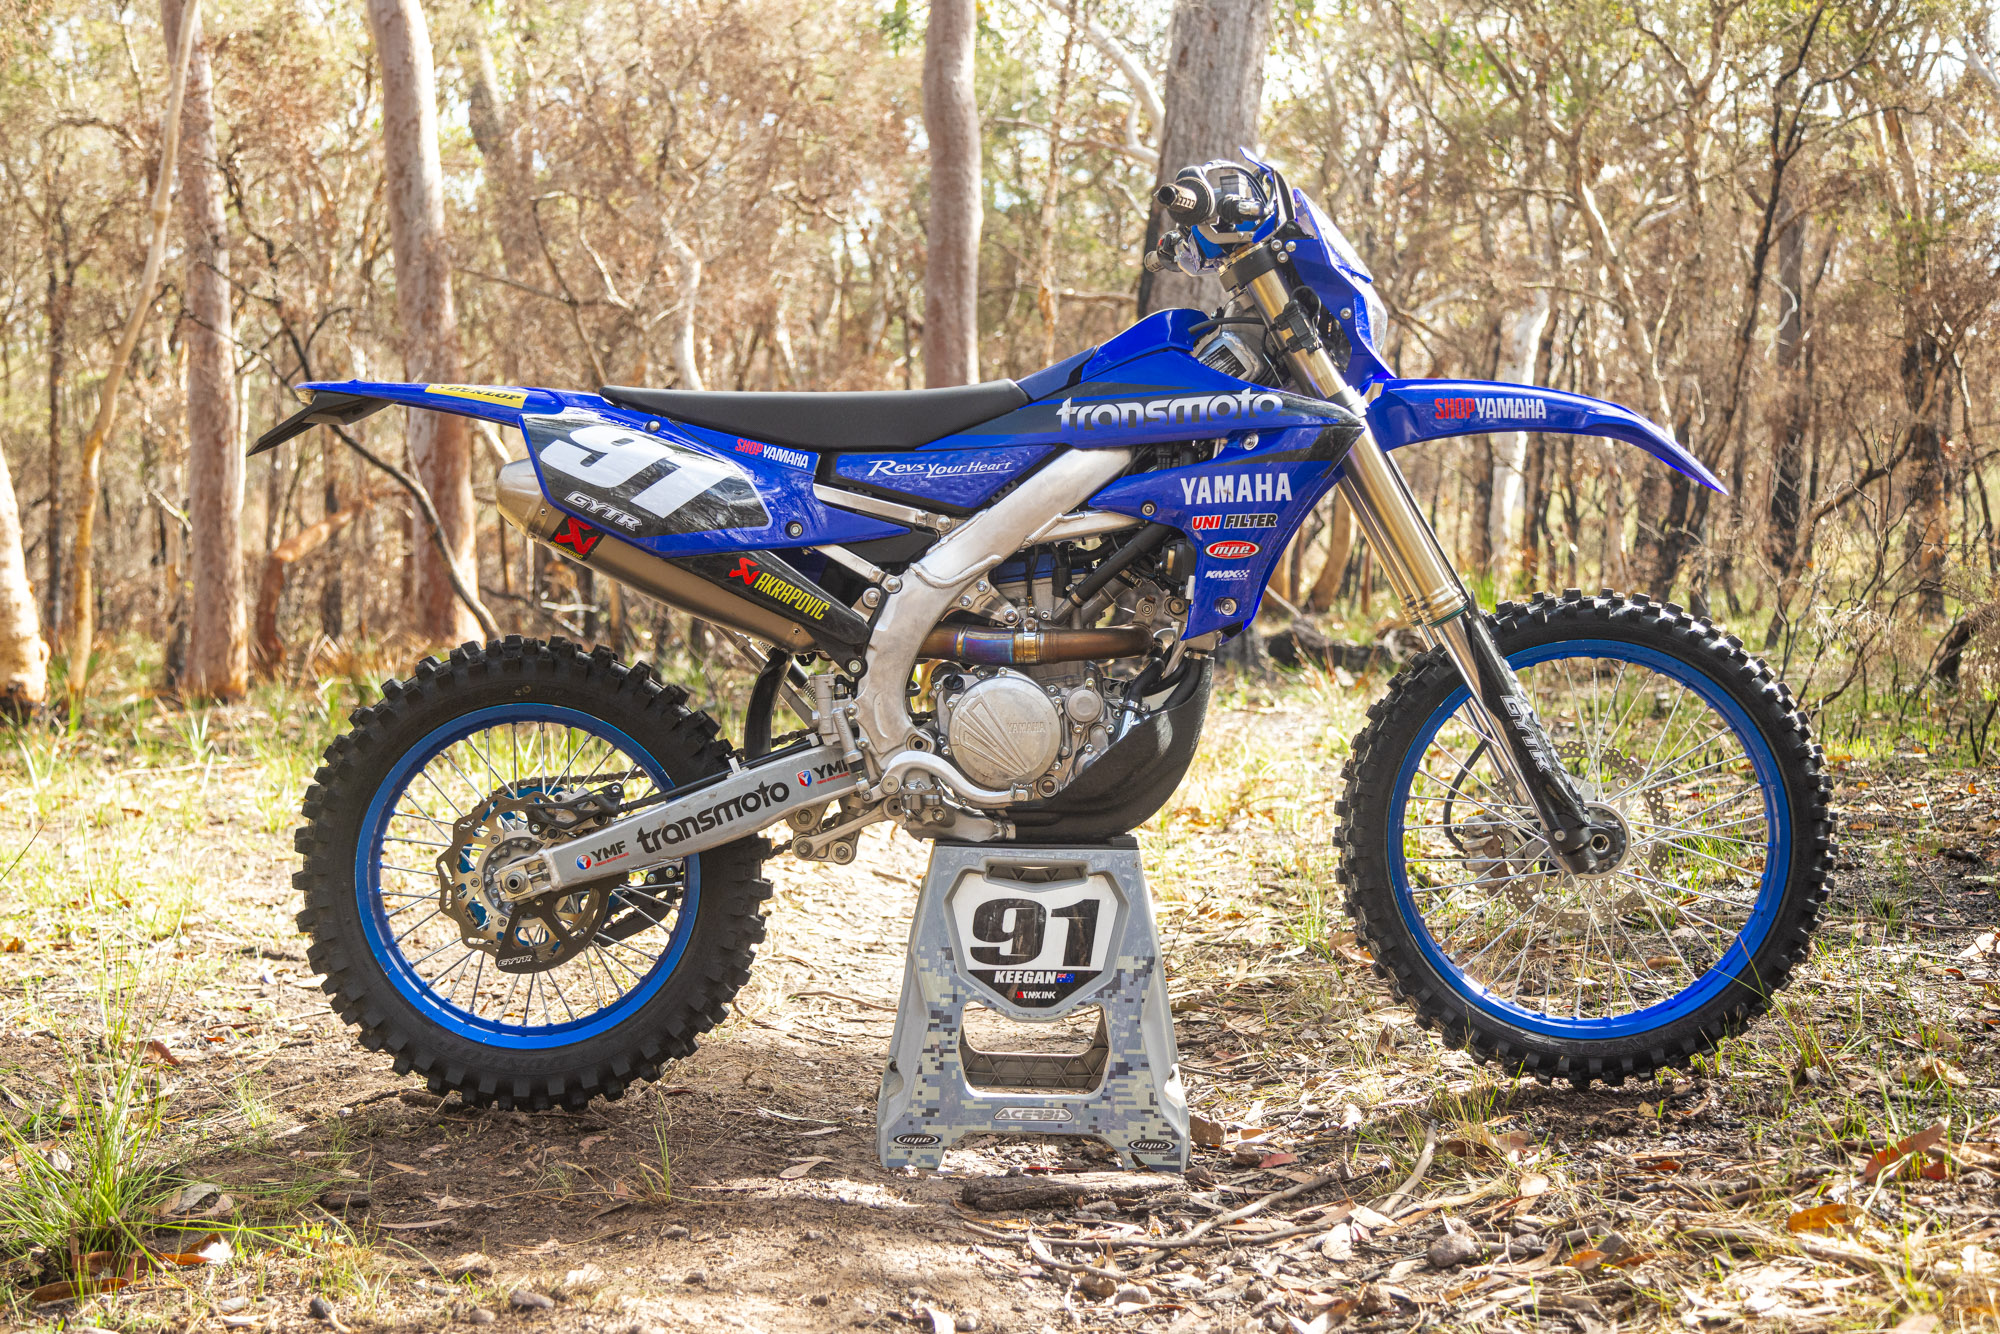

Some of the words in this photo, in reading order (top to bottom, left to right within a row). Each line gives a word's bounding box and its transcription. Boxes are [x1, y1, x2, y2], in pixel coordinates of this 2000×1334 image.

[1056, 387, 1284, 432] transmoto
[540, 426, 732, 519] 91
[1180, 473, 1292, 505] YAMAHA
[564, 491, 642, 531] GYTR
[1192, 515, 1222, 530] UNI
[1224, 513, 1278, 529] FILTER
[1205, 570, 1240, 579] KMX
[1500, 696, 1553, 773] GYTR
[636, 780, 790, 854] transmoto
[590, 840, 626, 862] YMF
[970, 898, 1100, 967] 91
[994, 970, 1057, 984] KEEGAN
